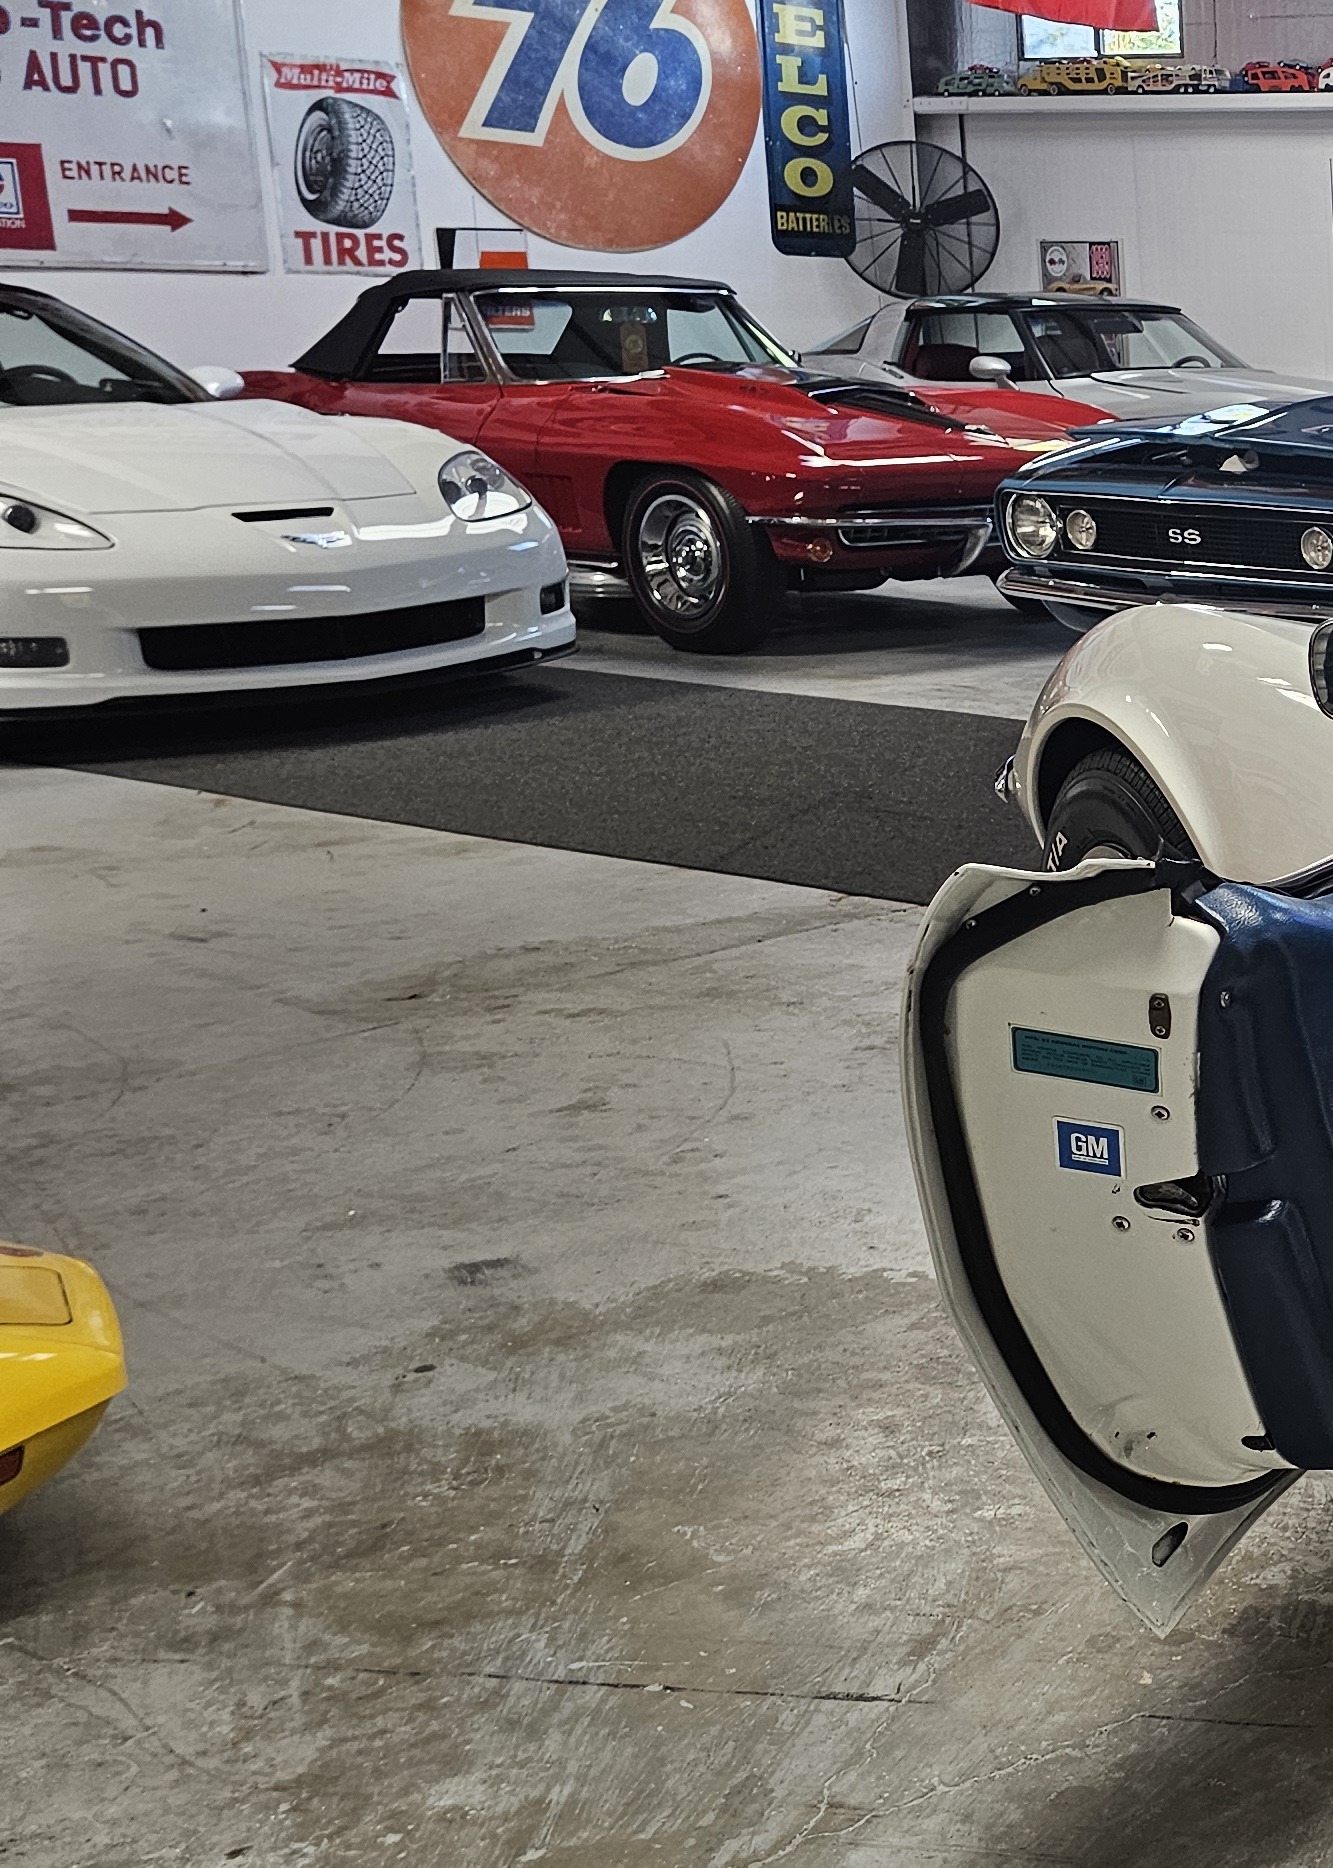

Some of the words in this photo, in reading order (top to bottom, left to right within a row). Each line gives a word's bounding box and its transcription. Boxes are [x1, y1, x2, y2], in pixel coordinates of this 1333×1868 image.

[23, 49, 139, 98] AUTO
[279, 66, 388, 91] Multi-Mile
[448, 0, 713, 162] 76
[60, 160, 192, 185] ENTRANCE
[777, 211, 850, 235] BATTERIES
[294, 230, 409, 268] TIRES
[1168, 529, 1201, 545] SS
[1071, 1132, 1108, 1159] GM
